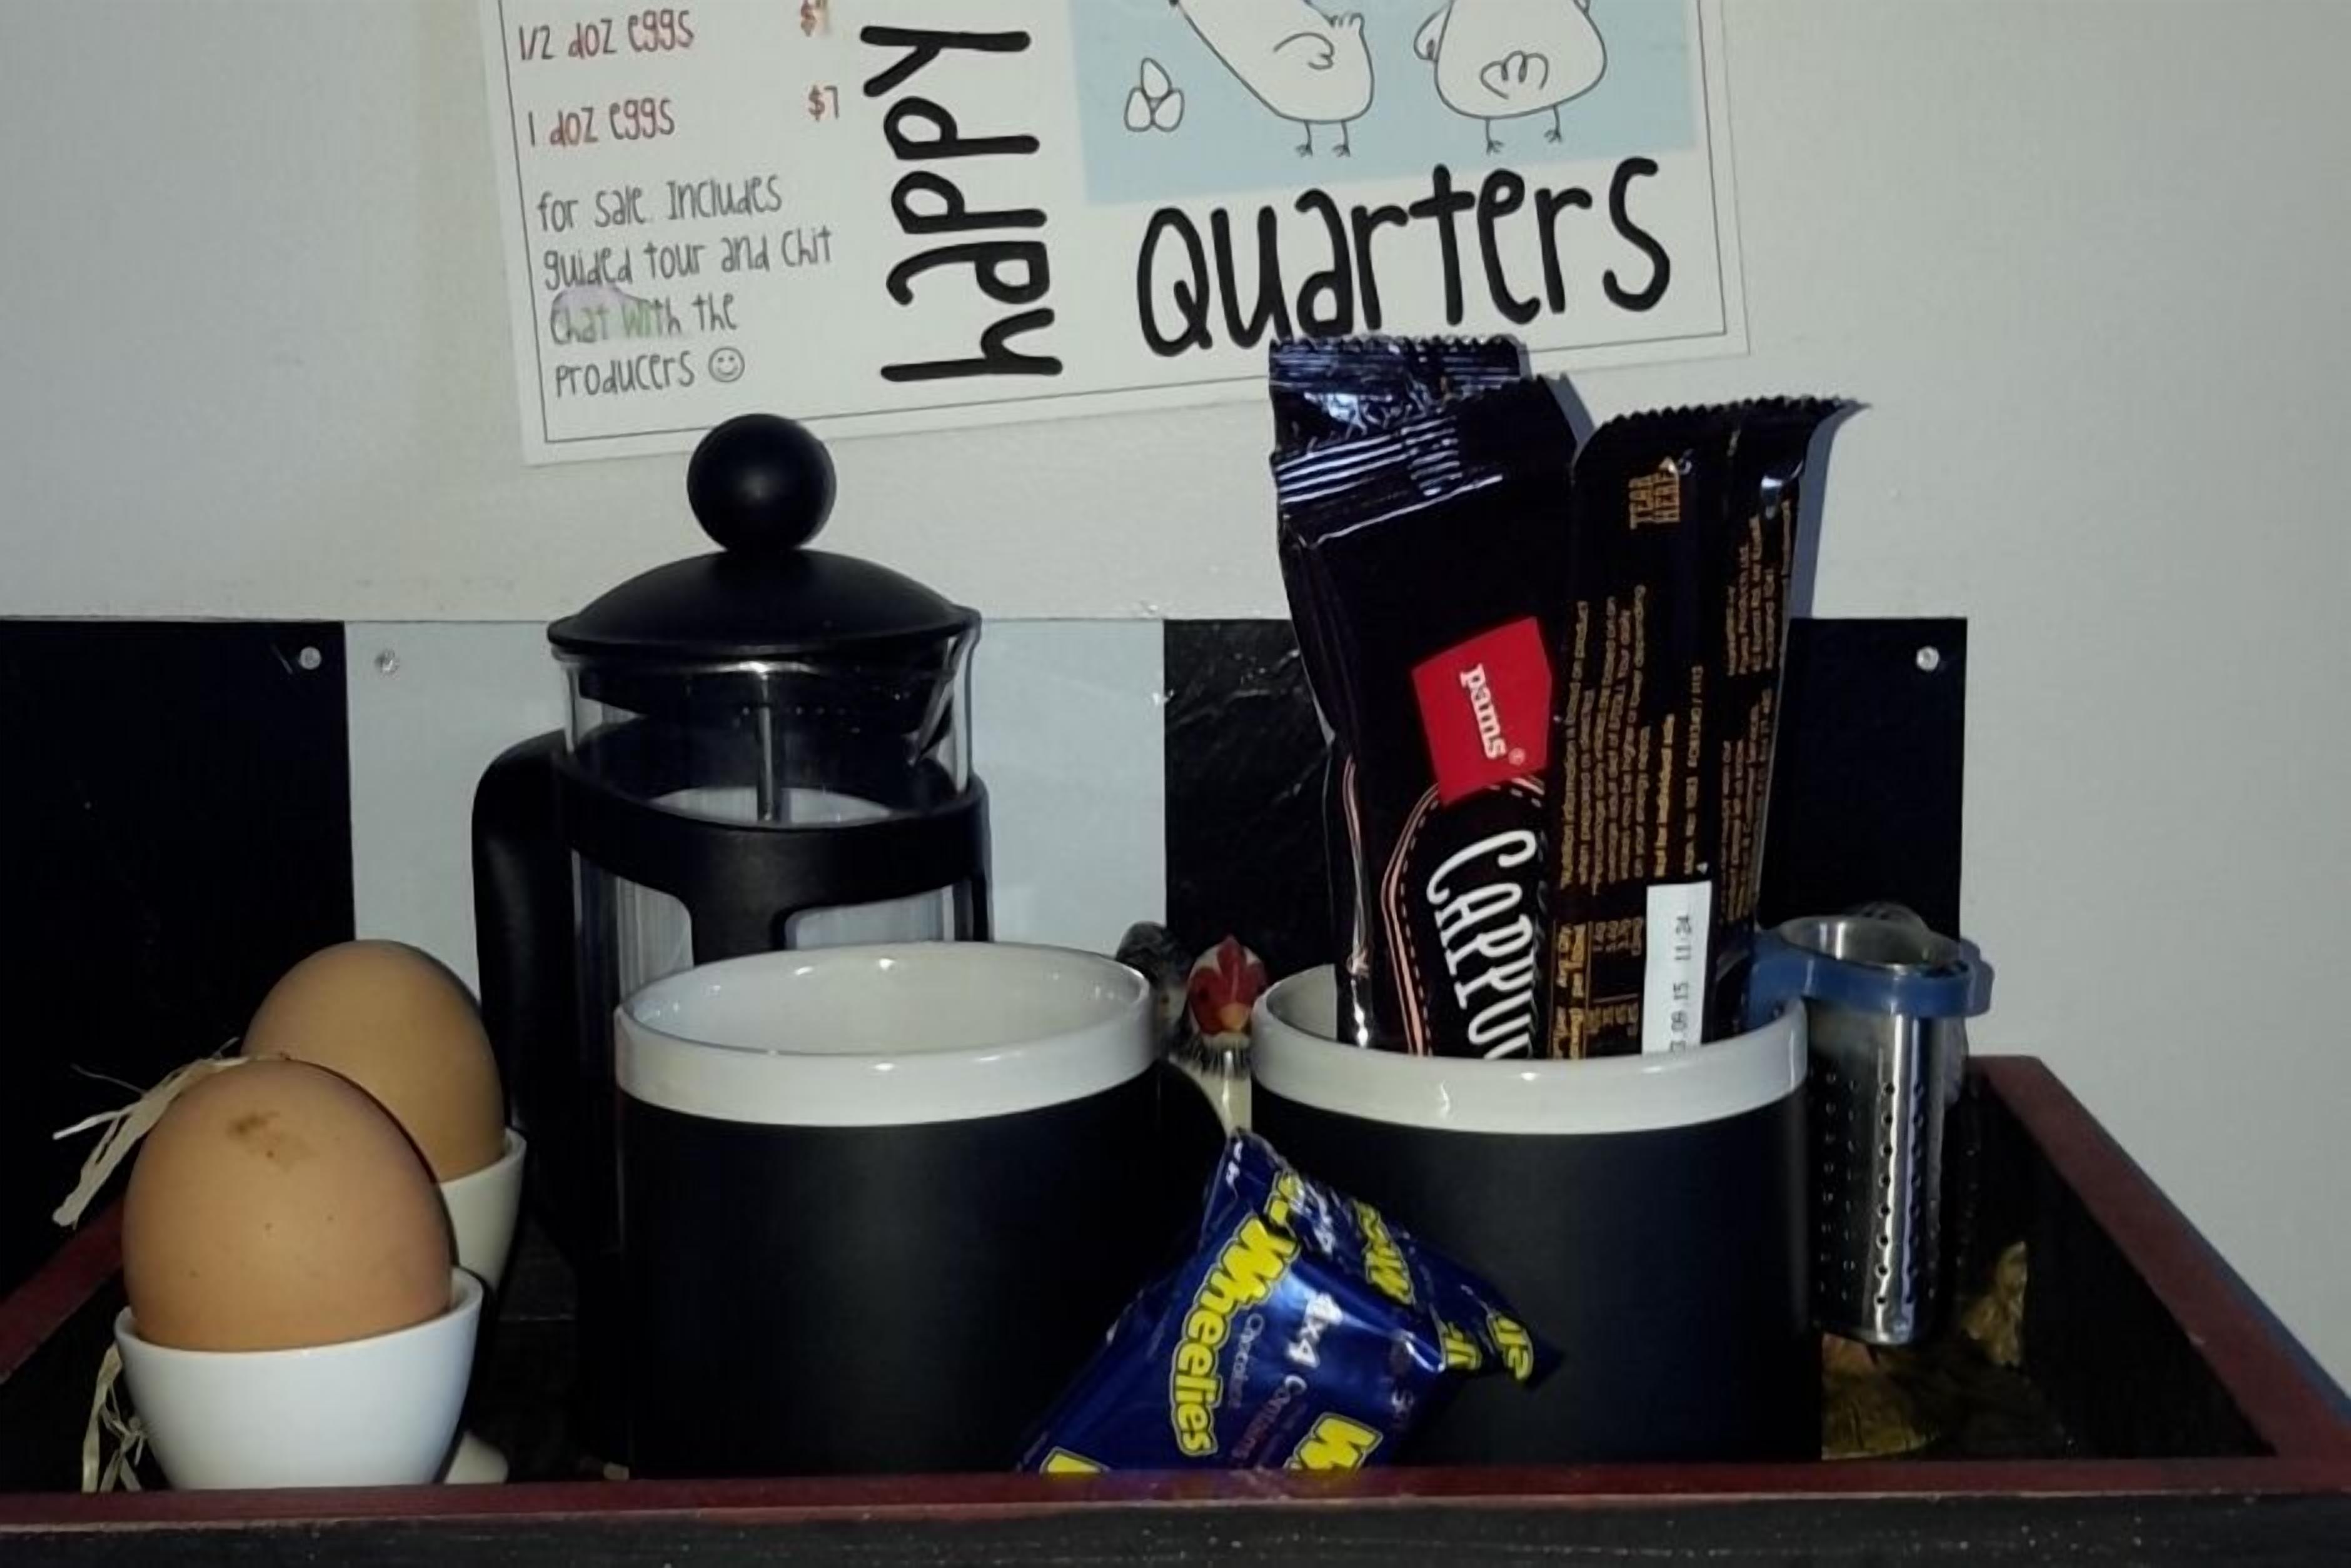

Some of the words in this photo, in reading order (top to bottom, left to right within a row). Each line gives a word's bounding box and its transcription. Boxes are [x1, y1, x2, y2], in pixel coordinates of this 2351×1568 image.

[627, 8, 695, 53] eggs
[608, 98, 677, 143] eggs
[807, 84, 840, 123] $7
[536, 191, 580, 233] for
[859, 25, 1064, 383] happy
[543, 246, 634, 292] guided
[643, 240, 708, 280] tour
[720, 234, 771, 274] and
[692, 291, 739, 332] the
[1459, 663, 1507, 760] pams
[1170, 1212, 1298, 1454] Wheelies
